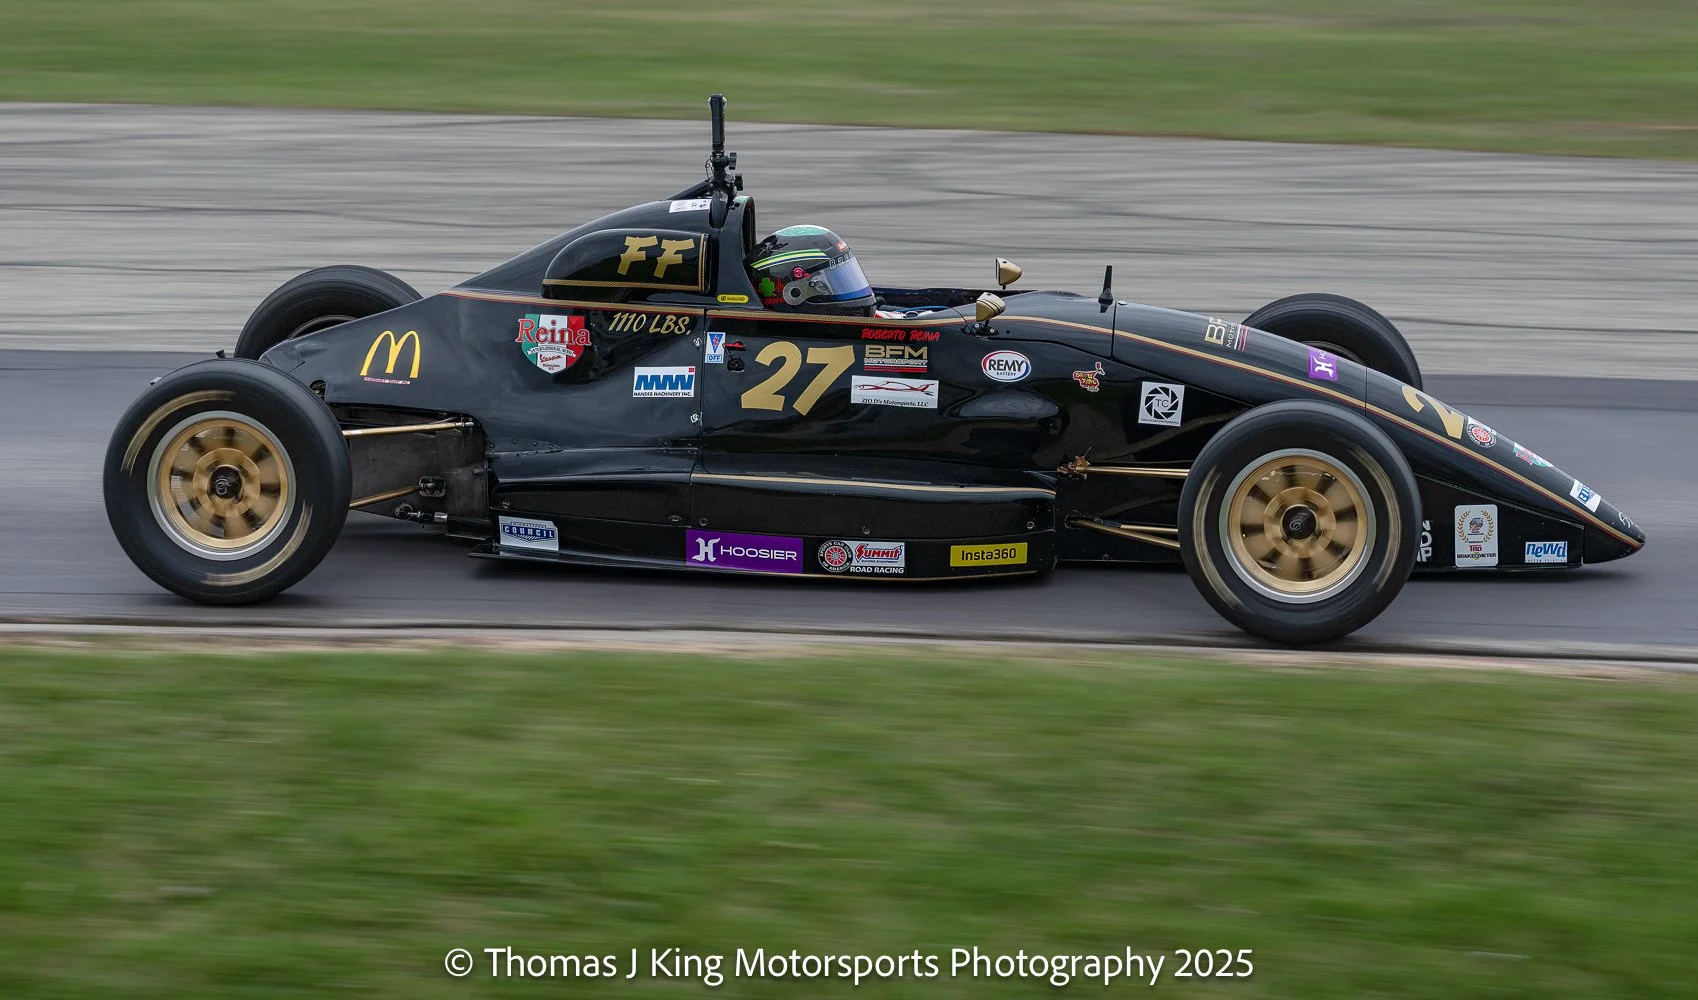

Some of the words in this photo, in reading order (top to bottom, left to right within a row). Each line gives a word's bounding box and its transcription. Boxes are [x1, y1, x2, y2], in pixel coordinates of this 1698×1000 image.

[617, 236, 695, 279] FF
[608, 312, 647, 333] 1110
[515, 318, 592, 346] Reina
[861, 328, 907, 340] ROBERTO
[909, 330, 941, 342] REINA
[864, 344, 928, 359] BFM
[988, 358, 1025, 373] REMY
[740, 340, 856, 416] 27
[1155, 398, 1169, 408] TC
[504, 525, 554, 538] COUNCIL
[720, 545, 798, 561] HOOSIER
[961, 547, 1017, 561] Insta360
